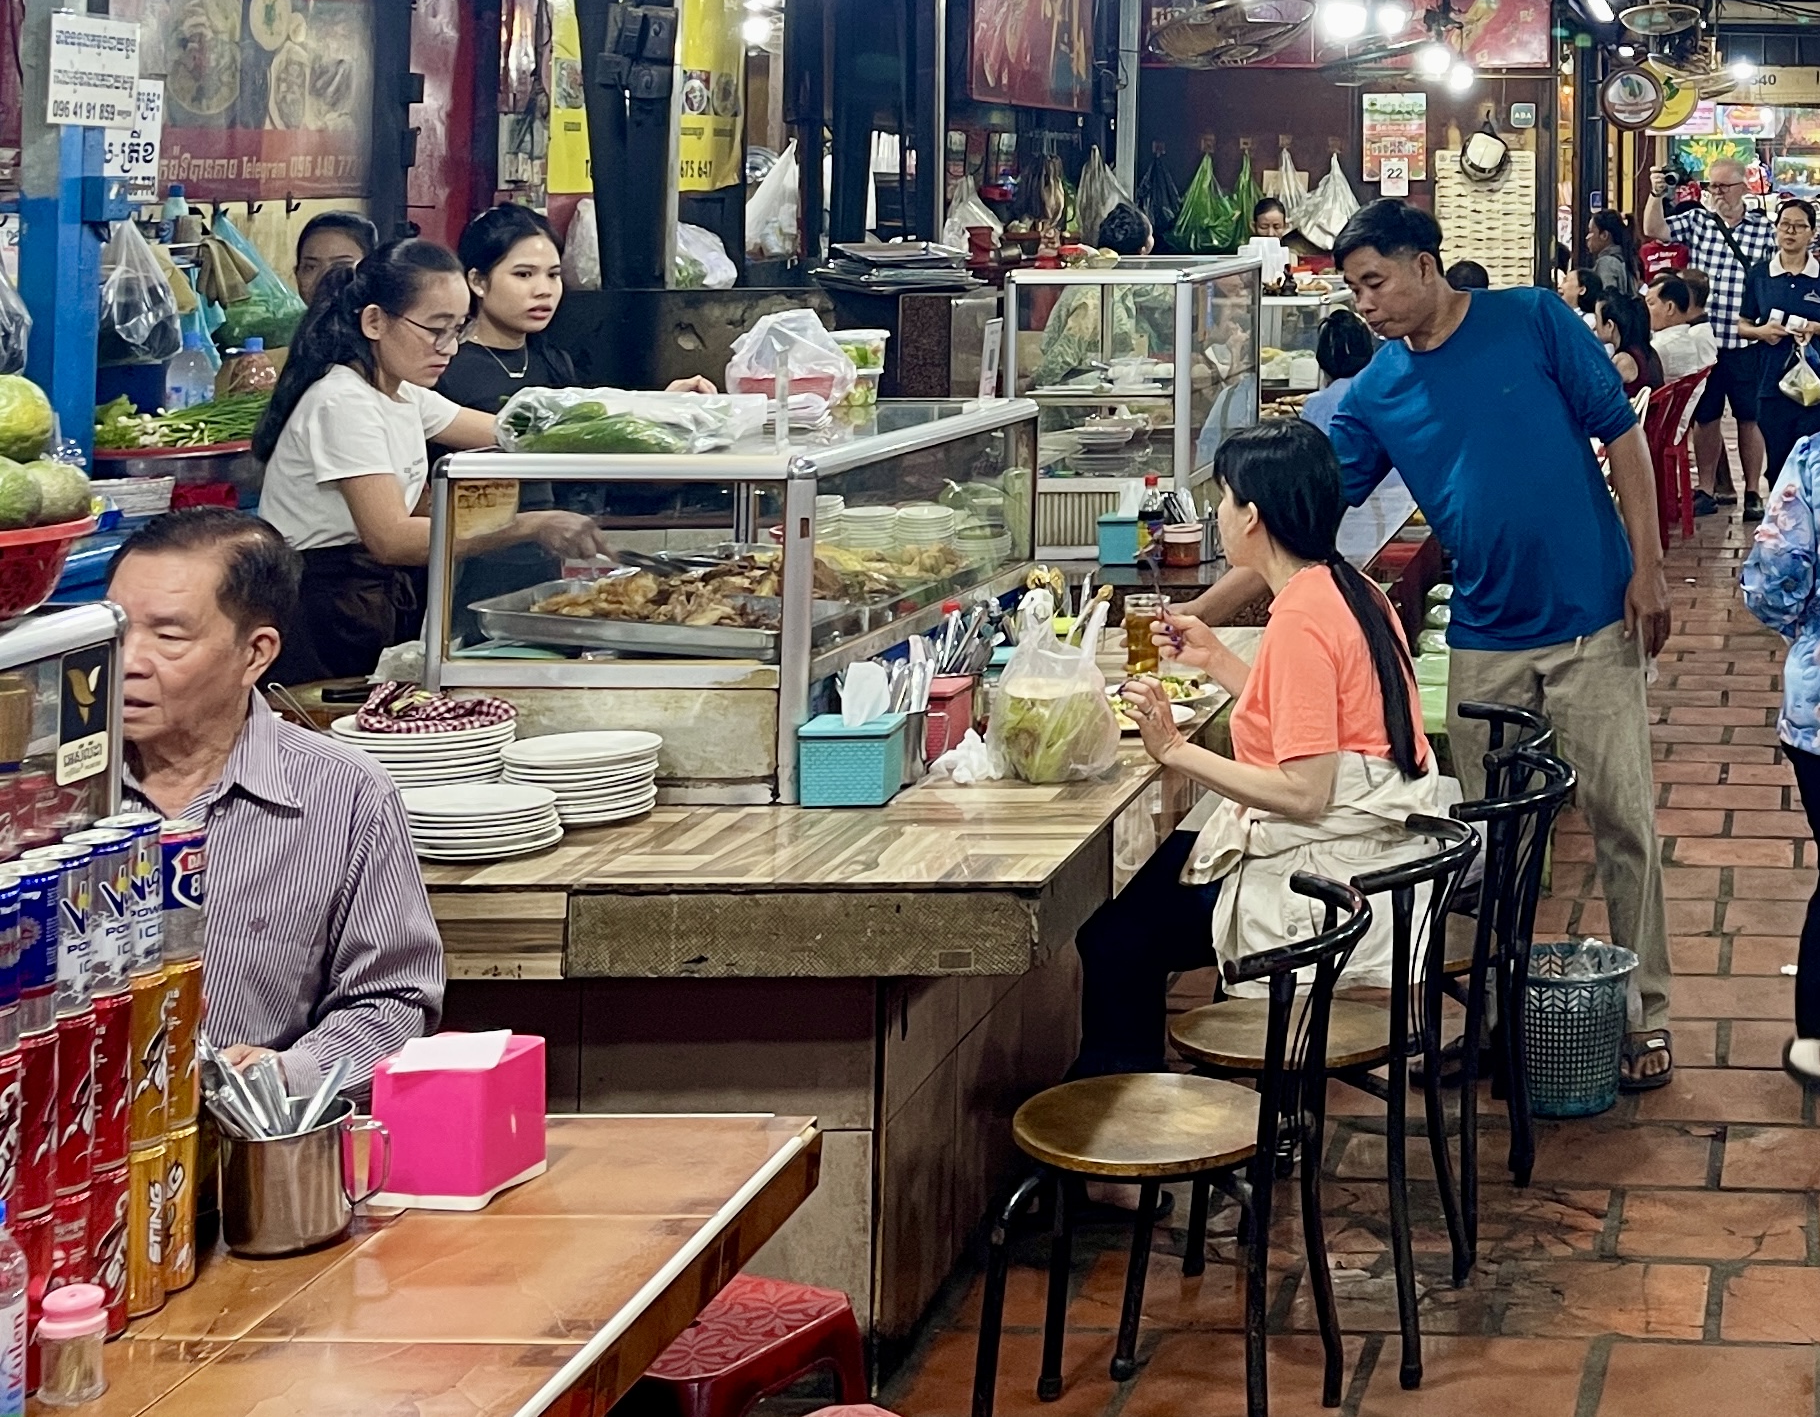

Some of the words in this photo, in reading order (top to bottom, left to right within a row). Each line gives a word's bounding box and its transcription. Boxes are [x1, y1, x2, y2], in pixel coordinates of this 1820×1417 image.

[53, 100, 70, 117] 096
[73, 102, 83, 119] 41
[86, 102, 96, 120] 91
[1514, 110, 1532, 119] ABA
[1387, 168, 1403, 180] 22
[148, 1182, 163, 1263] STING
